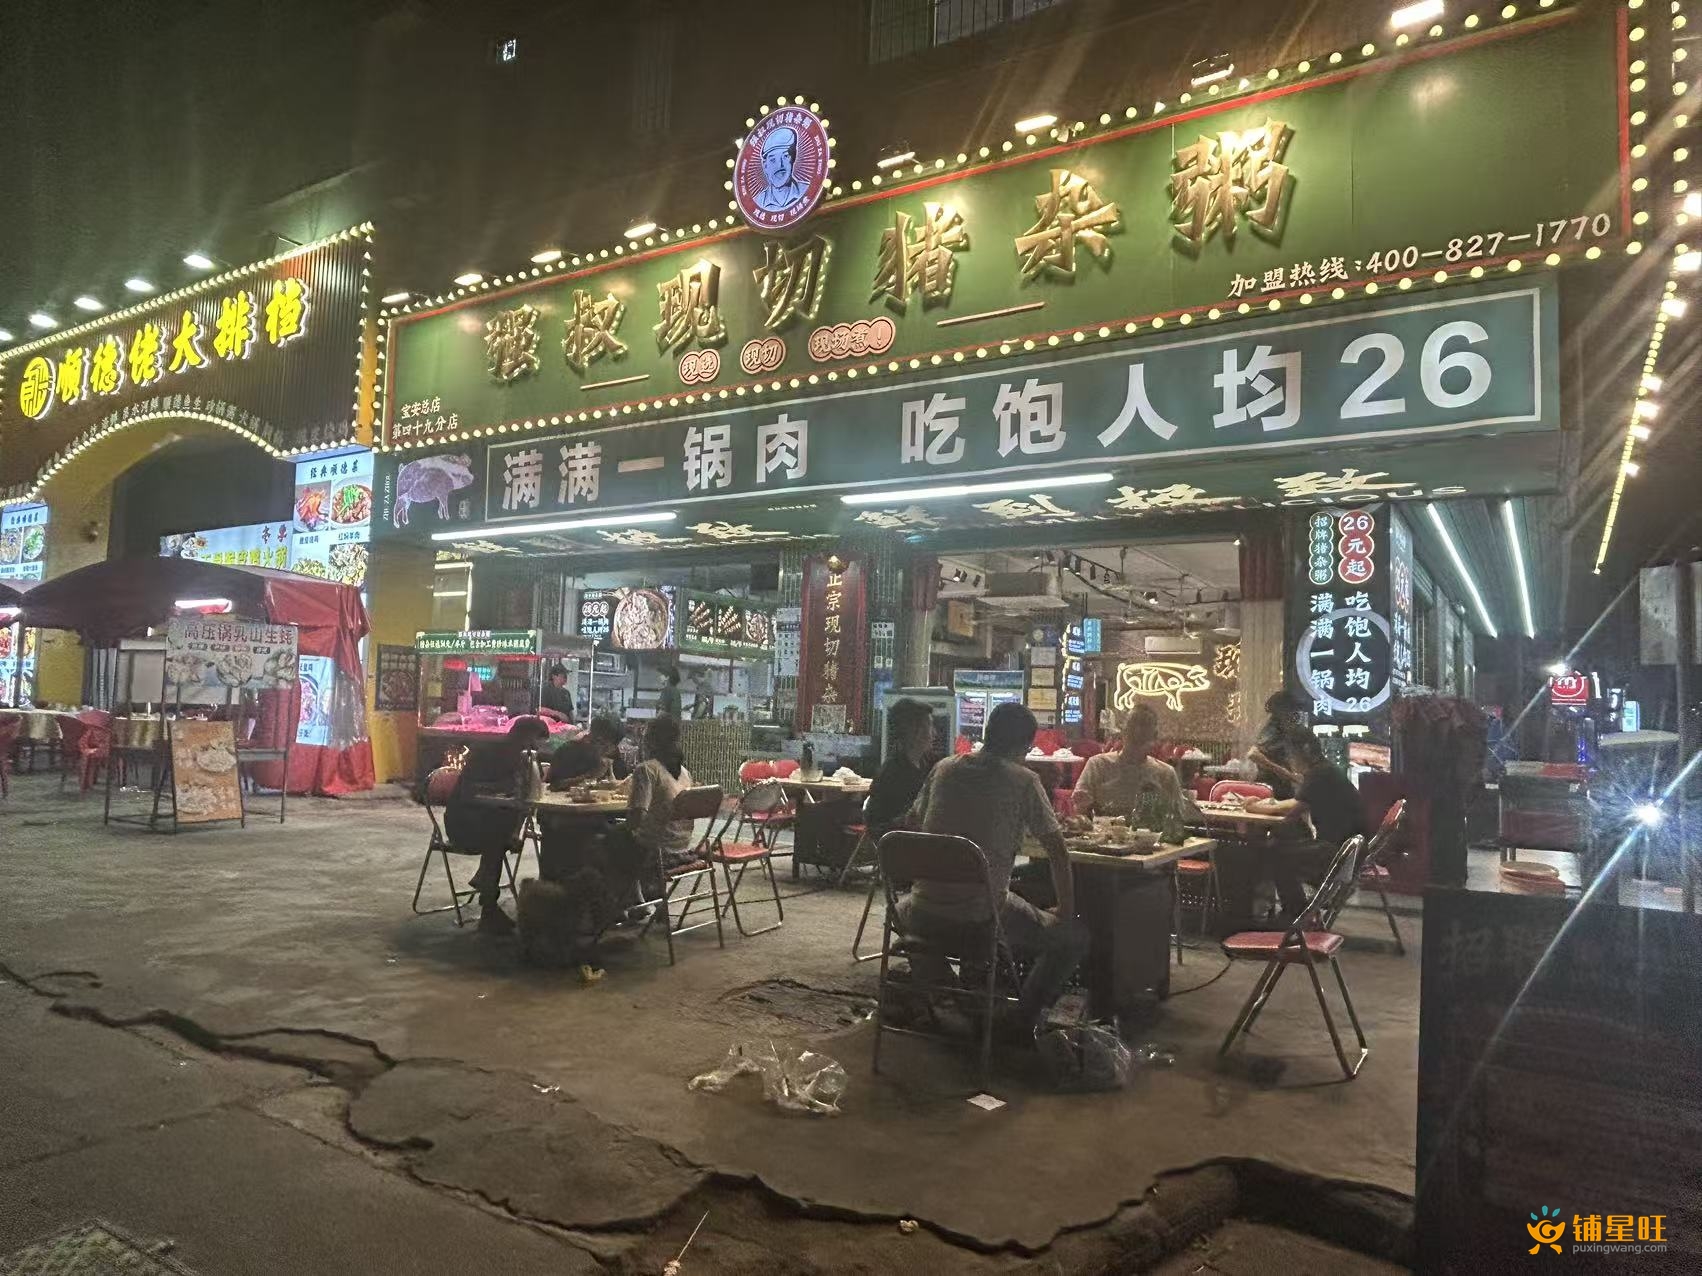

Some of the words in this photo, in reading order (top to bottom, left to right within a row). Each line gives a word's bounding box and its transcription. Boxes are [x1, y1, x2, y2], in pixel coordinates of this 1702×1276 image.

[745, 341, 779, 367] 现切
[392, 412, 458, 440] 第四十九分店
[401, 396, 441, 420] 宝安总店
[503, 412, 808, 511] 满满一锅肉
[901, 320, 1493, 466] 吃饱人均26
[1314, 515, 1328, 581] 招牌猪杂粥
[1310, 592, 1335, 716] 满满一锅肉
[1344, 591, 1372, 713] 吃饱人均26
